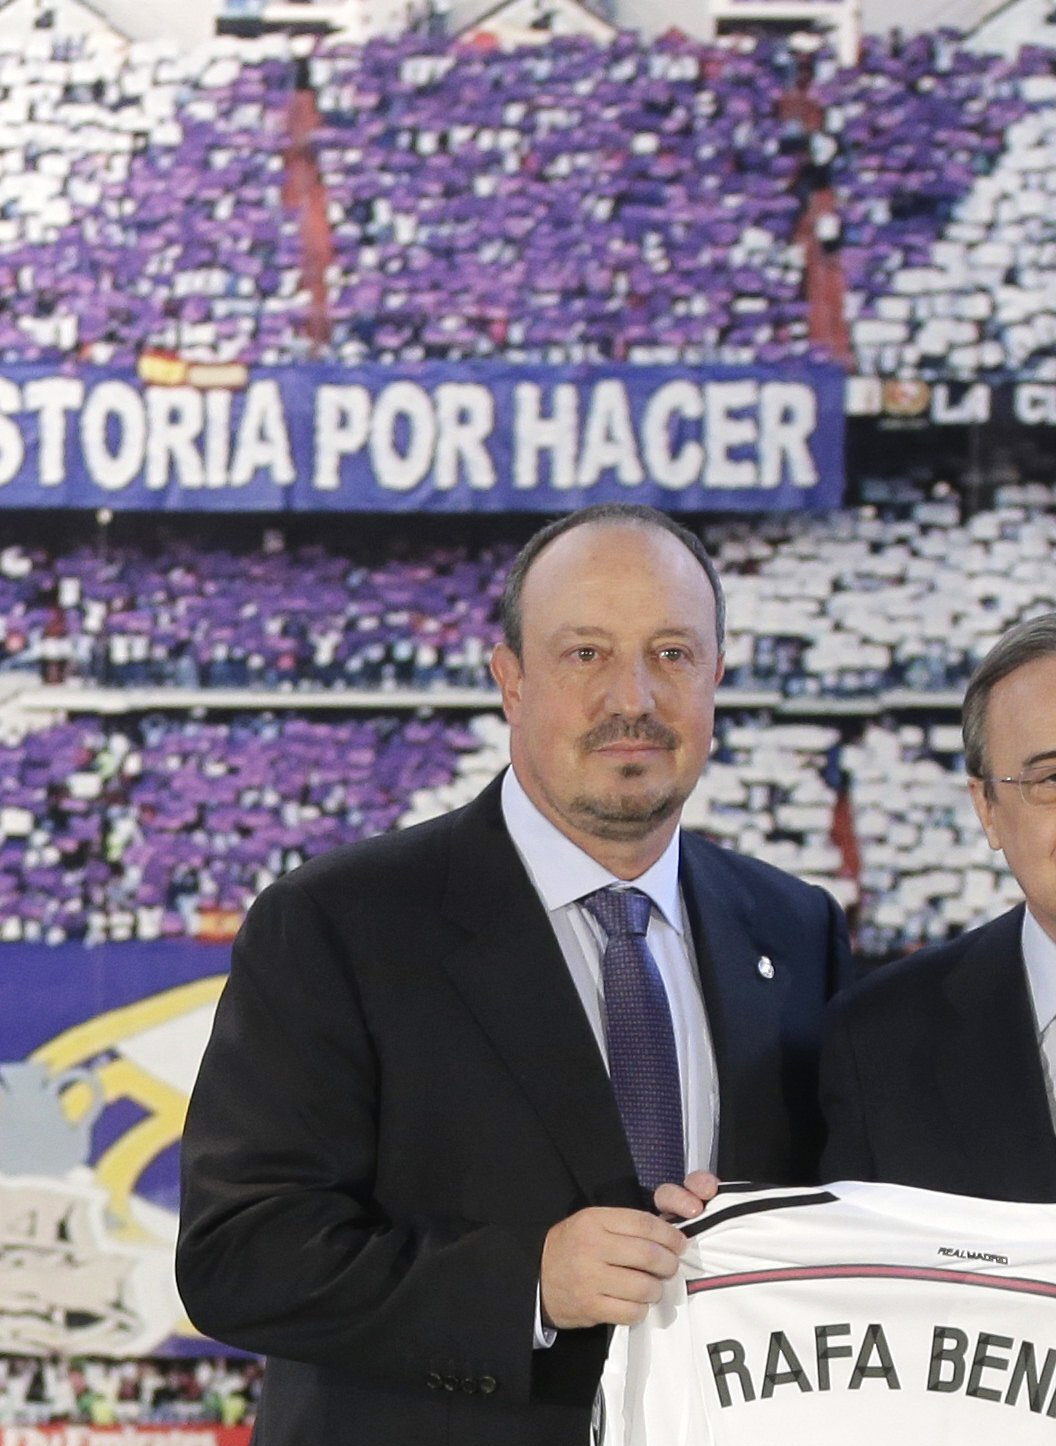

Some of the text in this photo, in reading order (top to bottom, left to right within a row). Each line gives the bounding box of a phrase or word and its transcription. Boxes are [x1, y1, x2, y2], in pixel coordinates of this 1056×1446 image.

[313, 380, 496, 492] POR
[513, 378, 817, 490] HACER
[706, 1323, 901, 1408] RAFA
